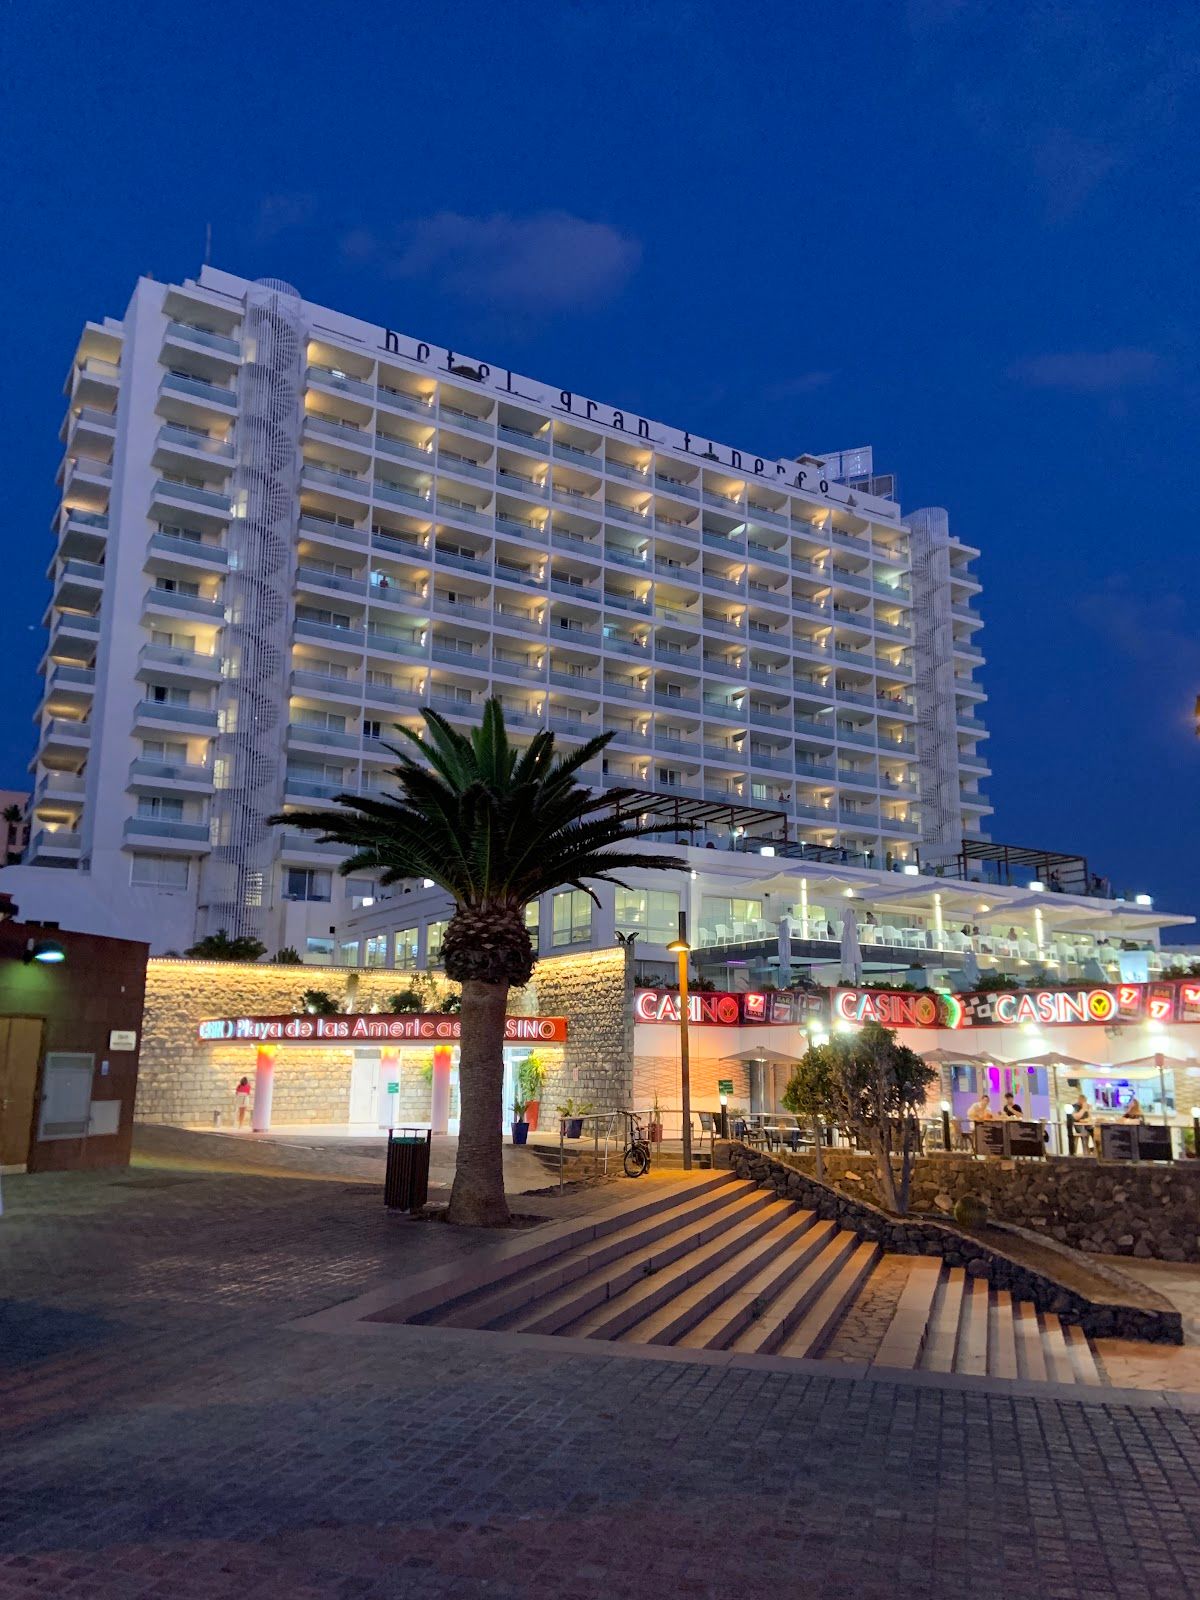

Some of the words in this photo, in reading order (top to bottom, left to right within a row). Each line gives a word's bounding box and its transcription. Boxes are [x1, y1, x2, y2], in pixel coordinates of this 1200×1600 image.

[385, 328, 511, 393] hotel
[560, 391, 649, 439] gran
[837, 992, 936, 1025] CASINO
[995, 989, 1116, 1024] CASINO
[236, 1018, 282, 1039] Playa
[285, 1018, 313, 1038] de
[316, 1018, 349, 1038] las
[351, 1017, 461, 1038] Americas
